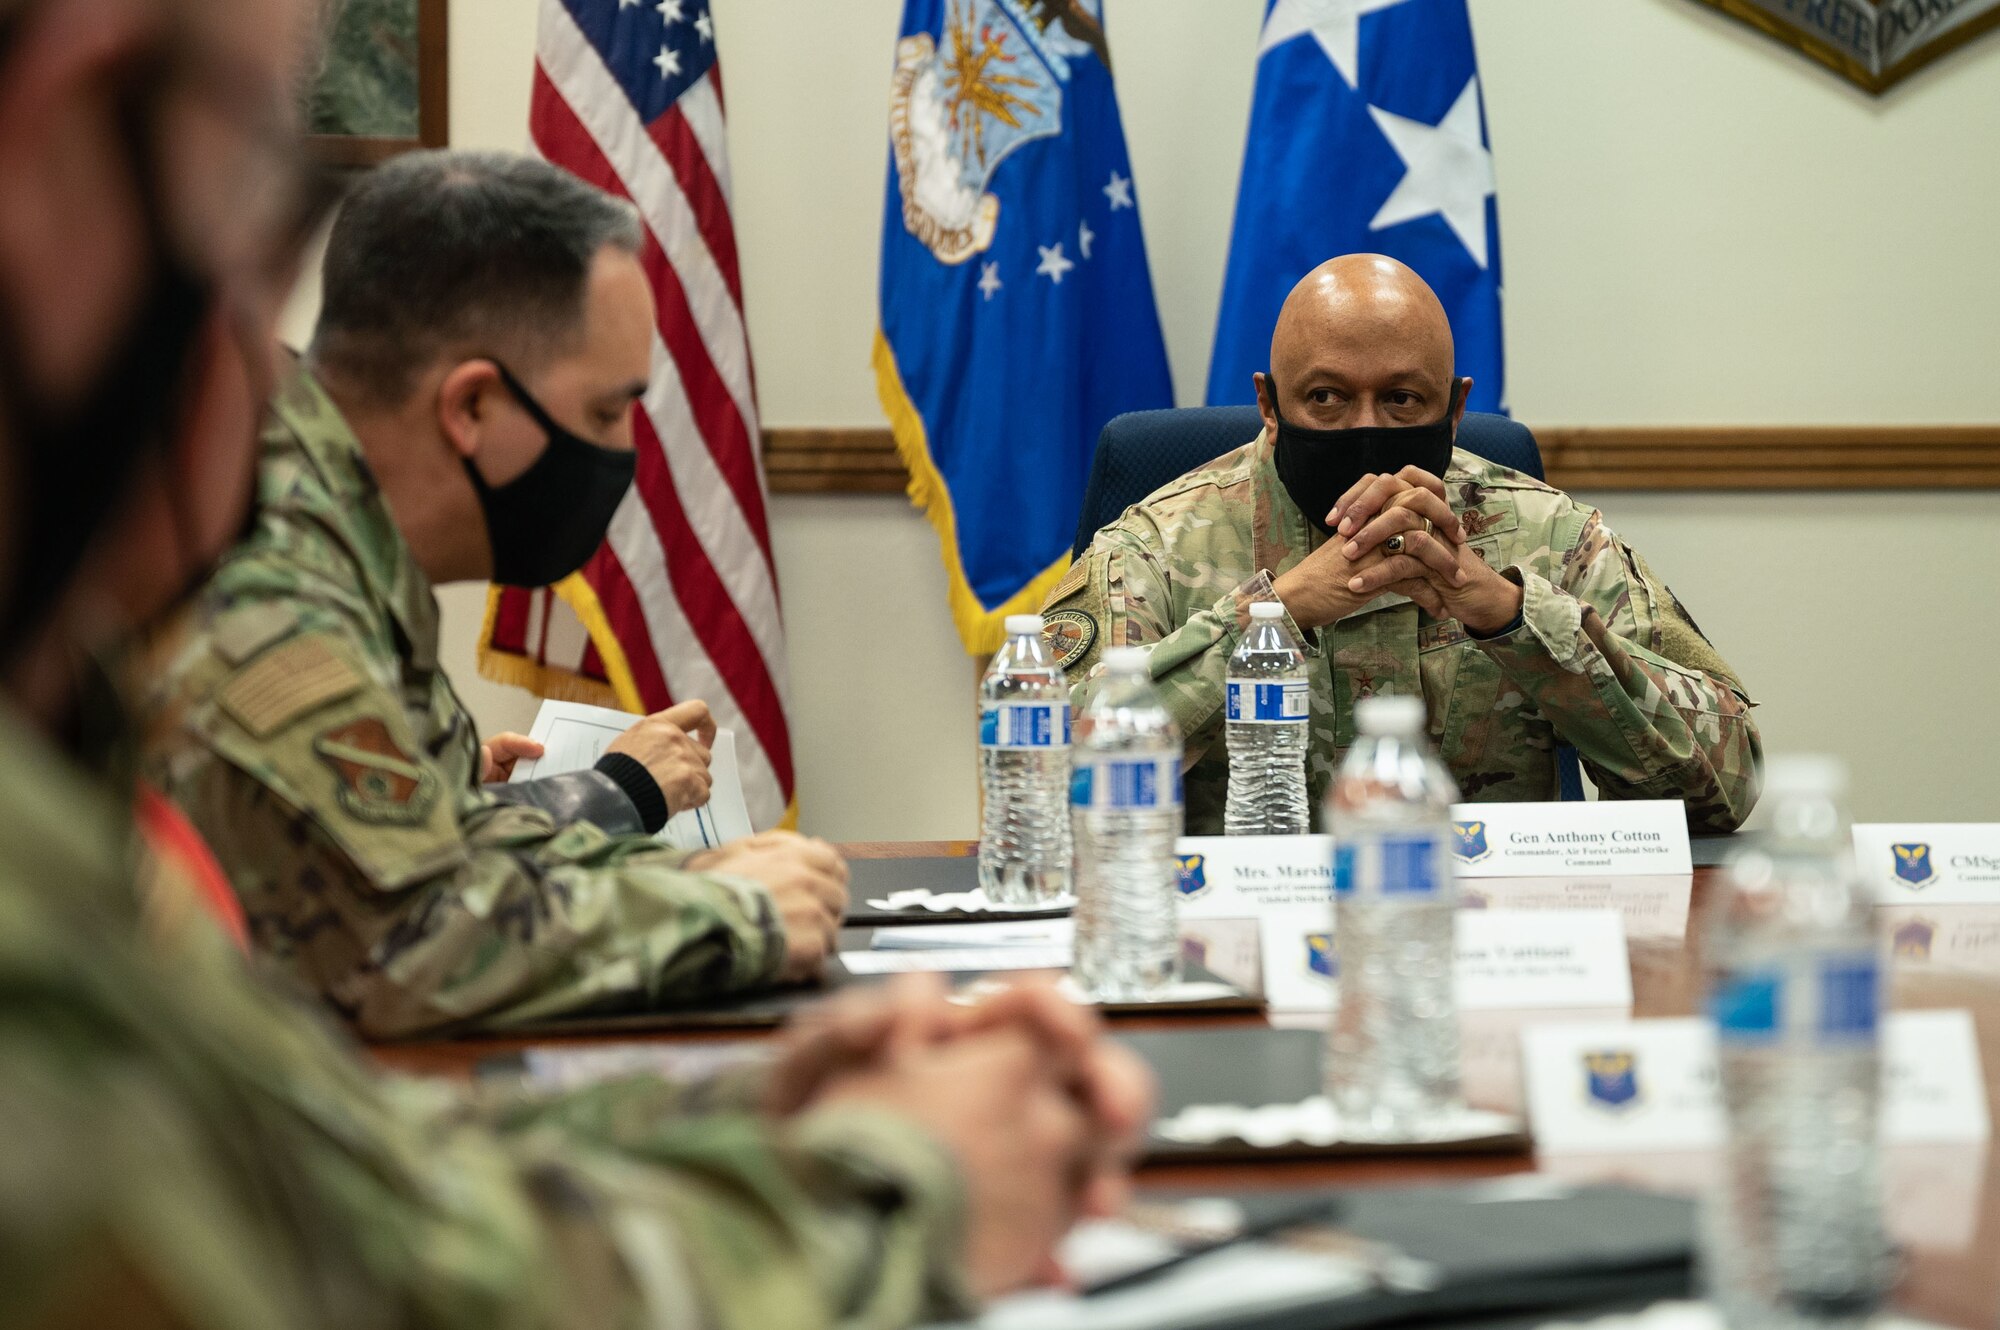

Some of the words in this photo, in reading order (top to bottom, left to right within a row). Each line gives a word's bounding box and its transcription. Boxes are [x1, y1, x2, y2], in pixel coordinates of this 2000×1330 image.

[1510, 831, 1539, 844] Gen
[1545, 831, 1606, 845] Anthony
[1611, 830, 1661, 842] Cotton
[1504, 848, 1564, 857] Commander,
[1566, 848, 1580, 856] Air
[1583, 847, 1608, 856] Force
[1610, 846, 1641, 855] Global
[1642, 846, 1669, 855] Strike
[1565, 858, 1612, 867] Command
[1950, 855, 2000, 871] CMSg
[1234, 866, 1271, 878] Mrs.
[1277, 865, 1336, 878] Marsh
